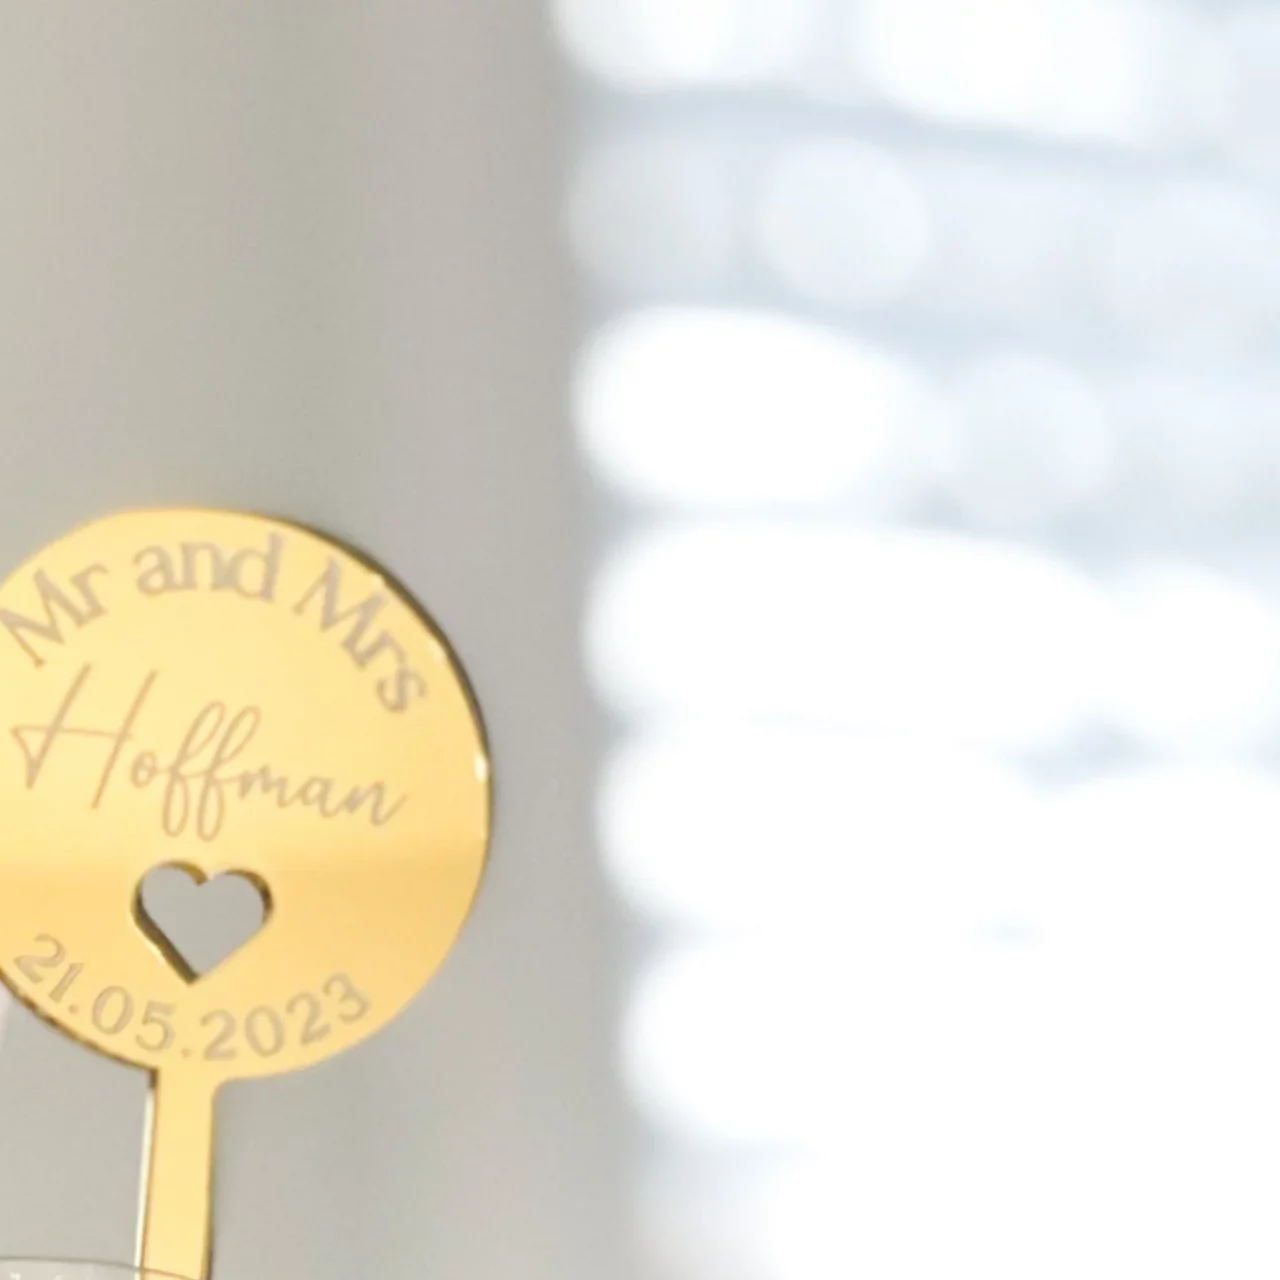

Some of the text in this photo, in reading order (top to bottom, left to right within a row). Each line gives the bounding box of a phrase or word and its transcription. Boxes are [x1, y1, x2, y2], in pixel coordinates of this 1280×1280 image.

[133, 531, 285, 603] and
[293, 558, 428, 713] Mrs
[9, 662, 407, 842] Hoffman
[13, 933, 372, 1062] 21.05.2023
